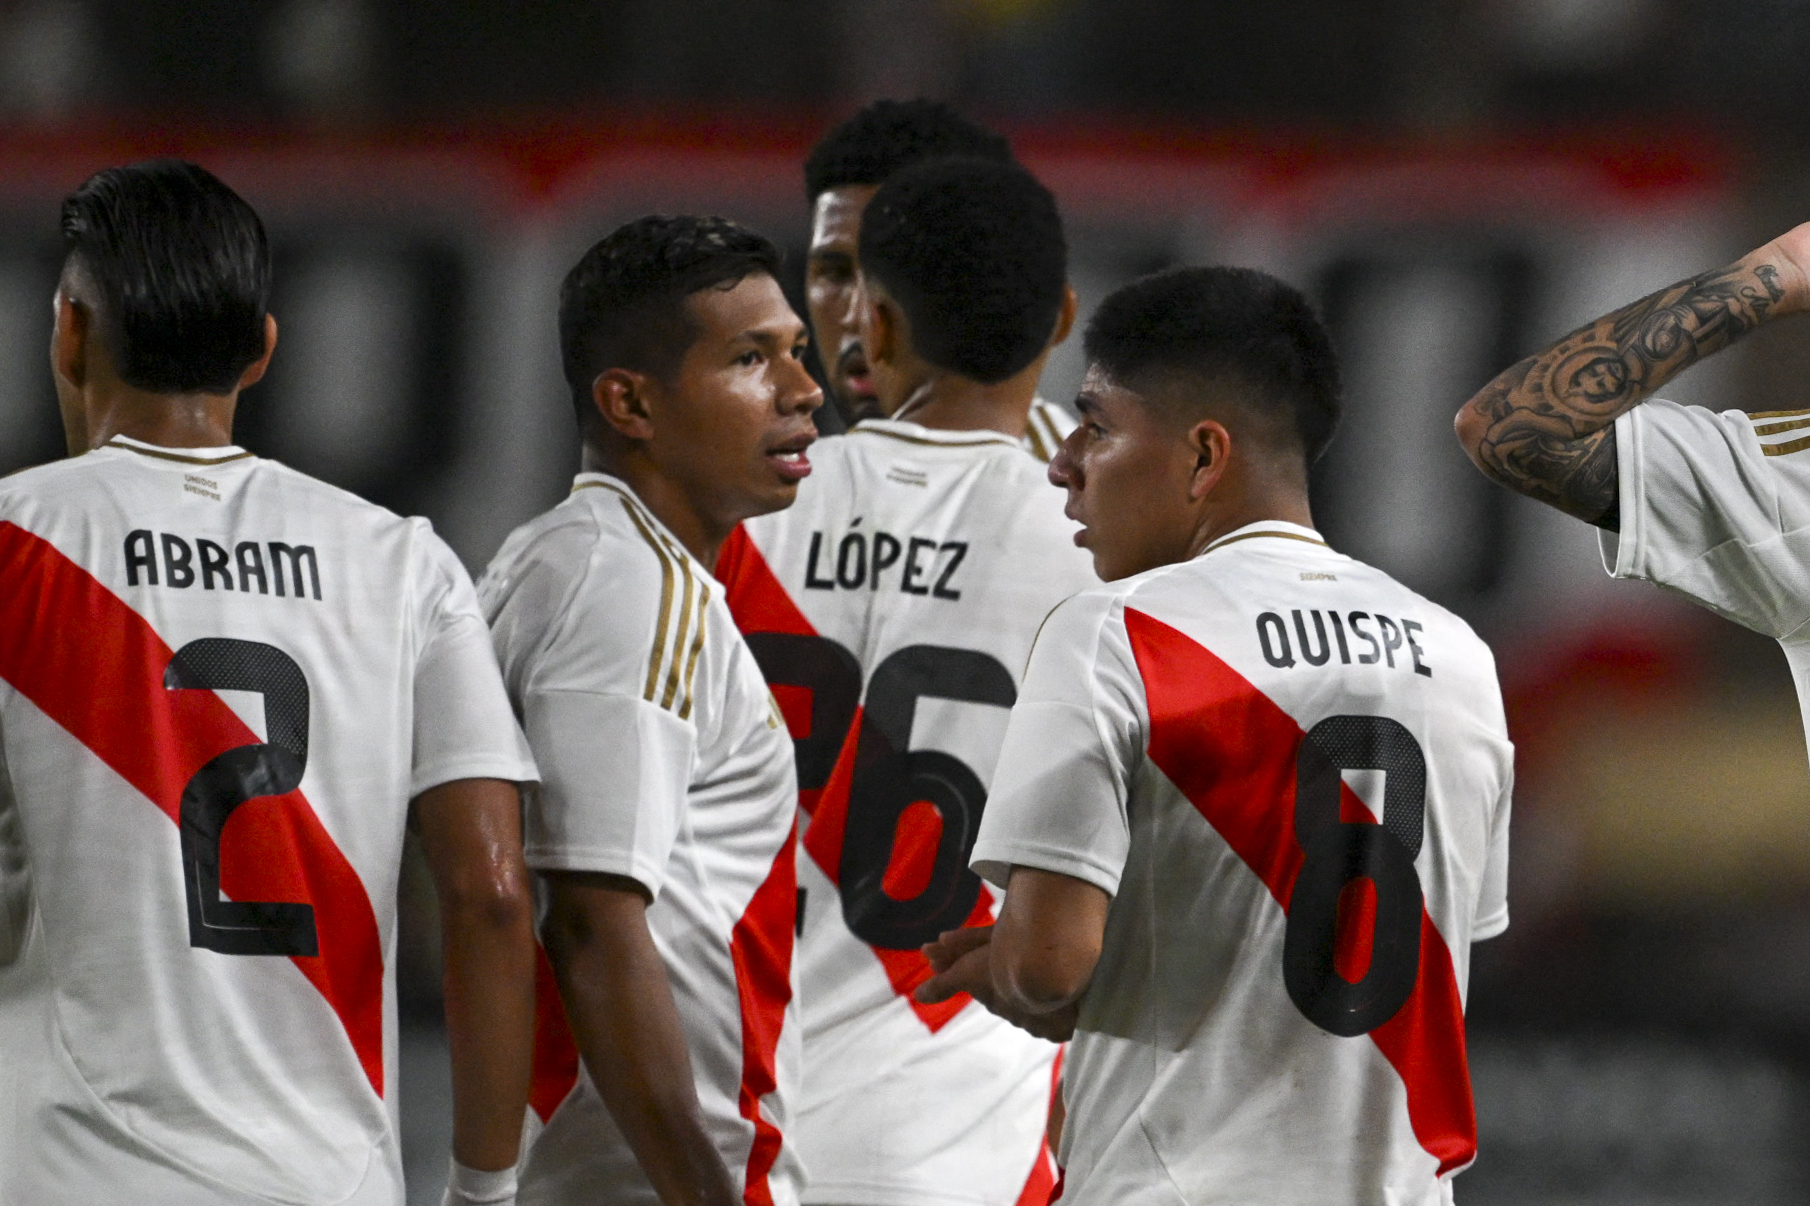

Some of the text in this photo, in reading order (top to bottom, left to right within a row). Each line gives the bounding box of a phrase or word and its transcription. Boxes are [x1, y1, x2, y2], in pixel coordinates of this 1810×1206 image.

[123, 529, 322, 601] ABRAM
[805, 518, 969, 600] LÓPEZ
[1256, 610, 1433, 679] QUISPE
[163, 637, 320, 957] 2
[1283, 715, 1427, 1038] 8
